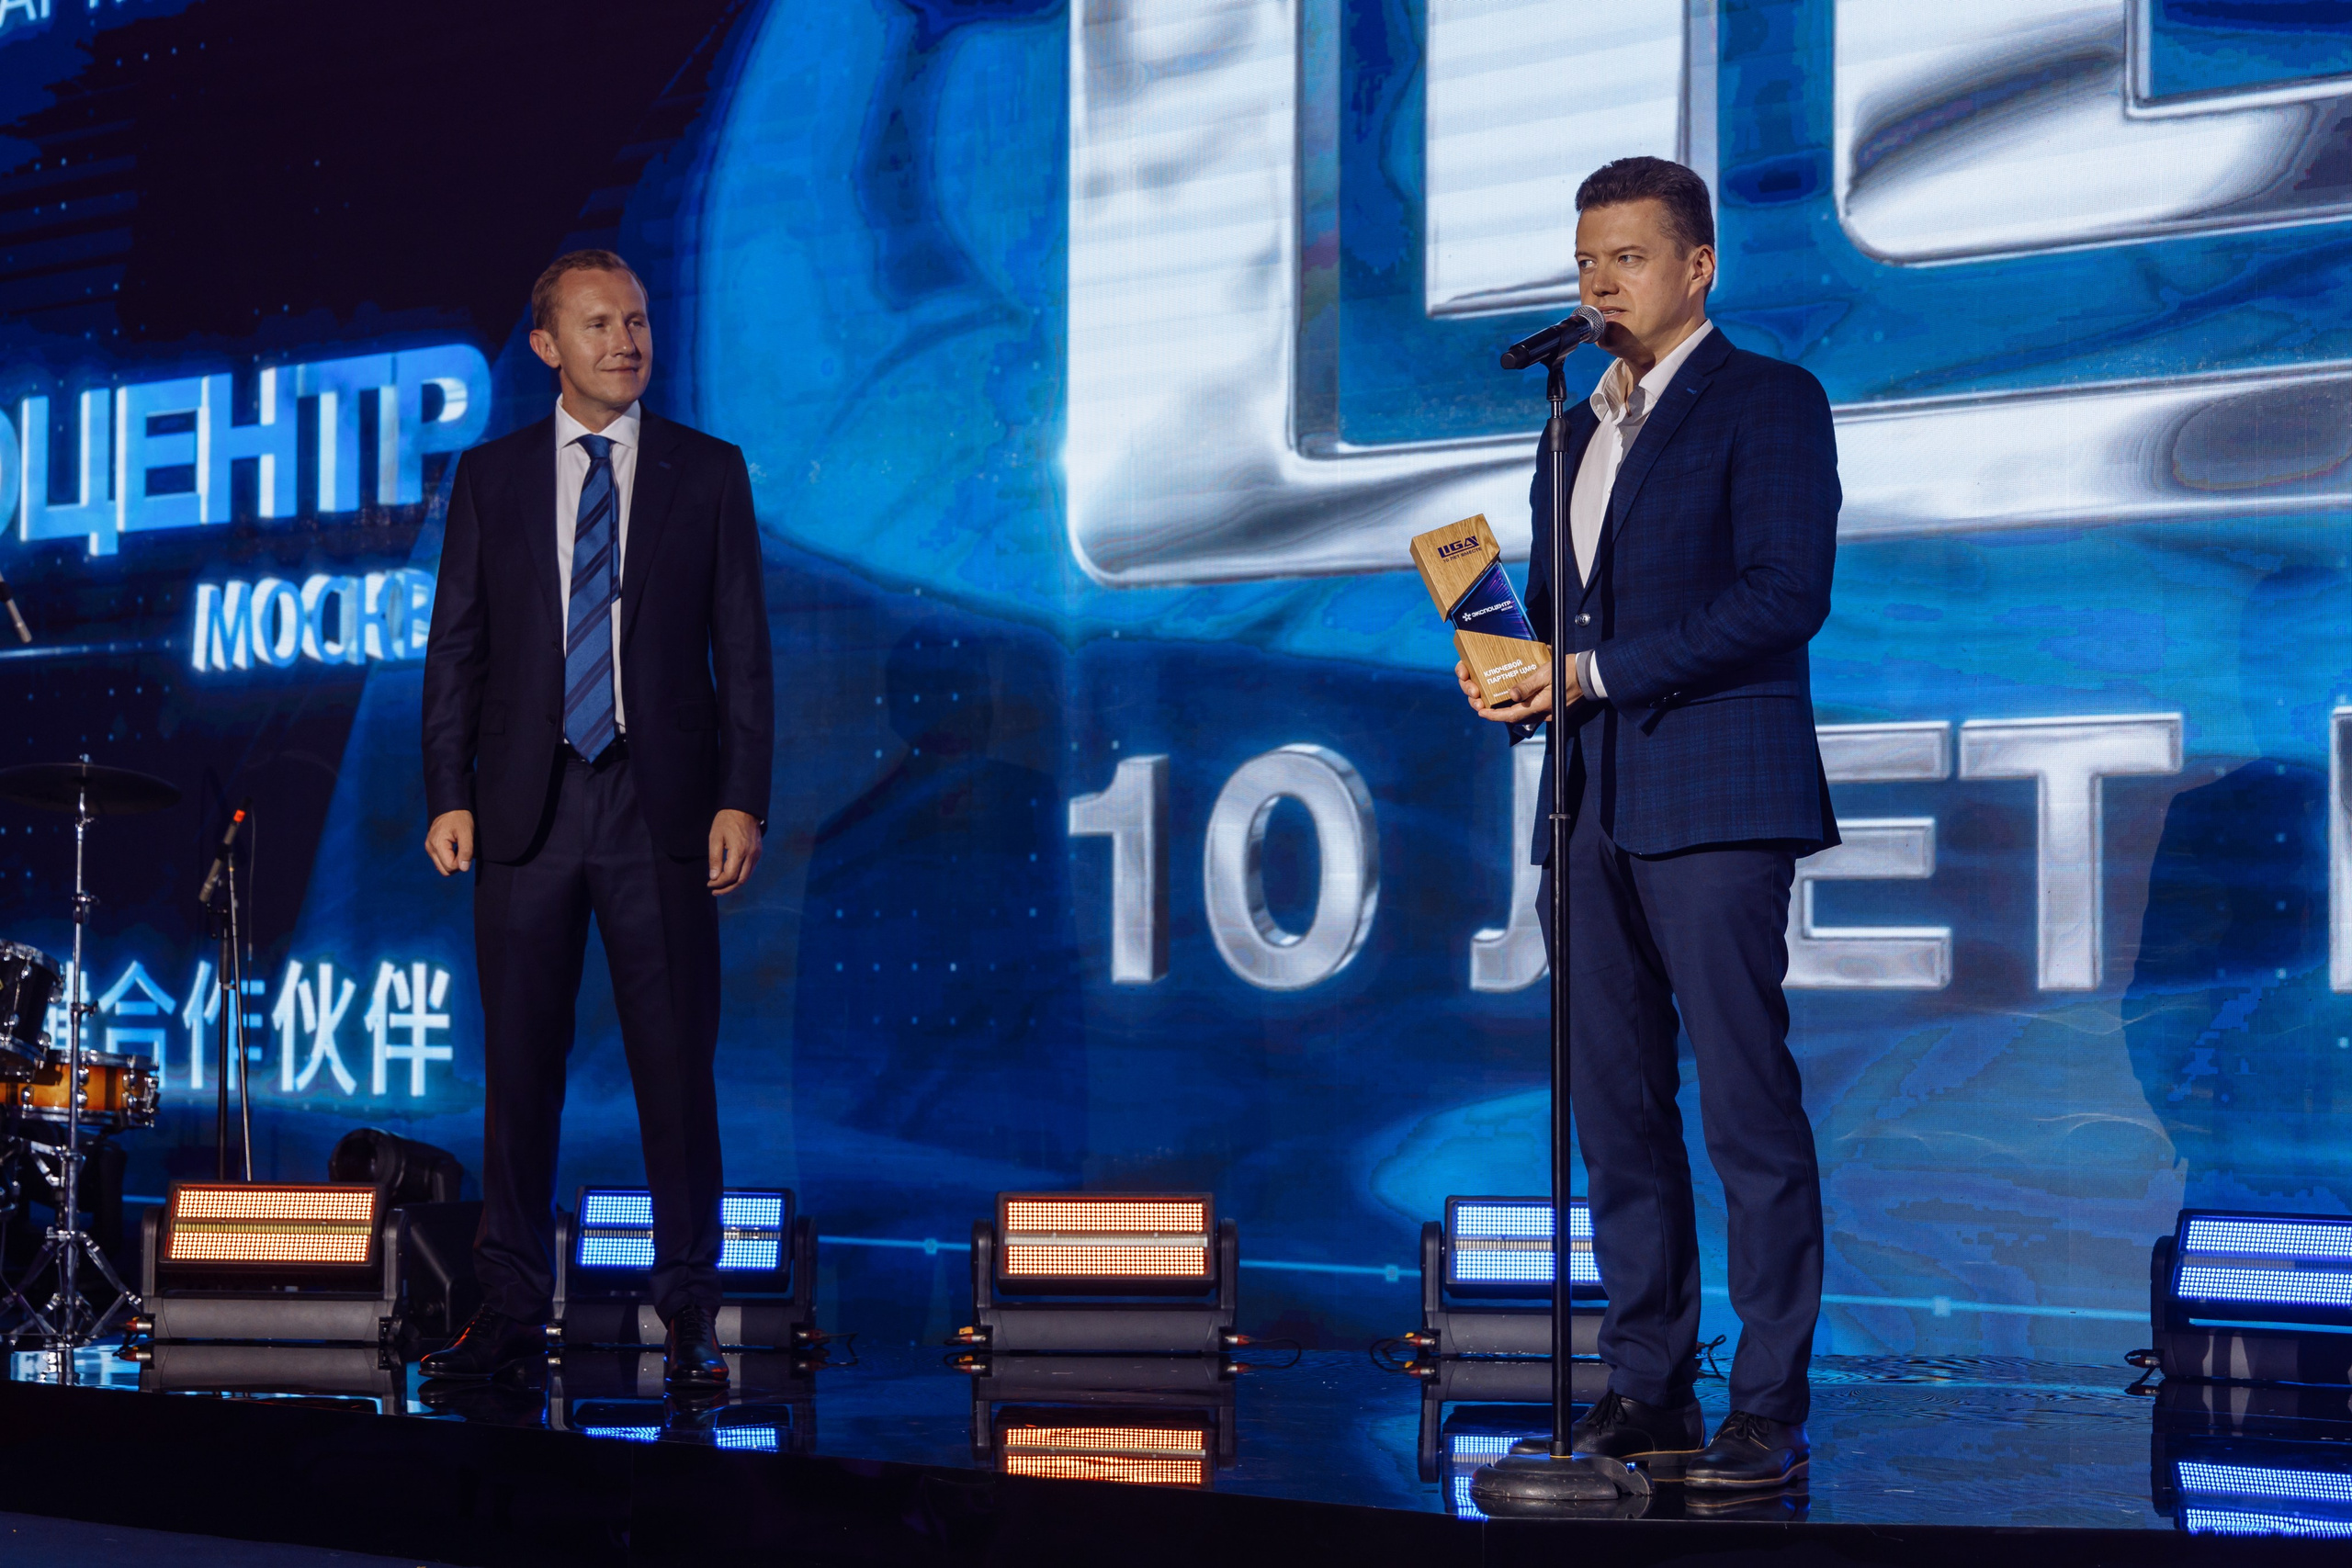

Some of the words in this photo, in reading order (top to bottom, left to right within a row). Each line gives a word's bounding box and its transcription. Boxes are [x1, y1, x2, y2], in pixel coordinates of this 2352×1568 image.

[0, 344, 492, 556] ЦЕНТР
[1471, 600, 1511, 617] ЭКСПОЦЕНТР
[1483, 659, 1523, 678] КЛЮЧЕВОЙ
[1487, 670, 1519, 685] ПАРТНЕР
[1519, 663, 1537, 675] ЦМФ
[1069, 744, 1378, 991] 10
